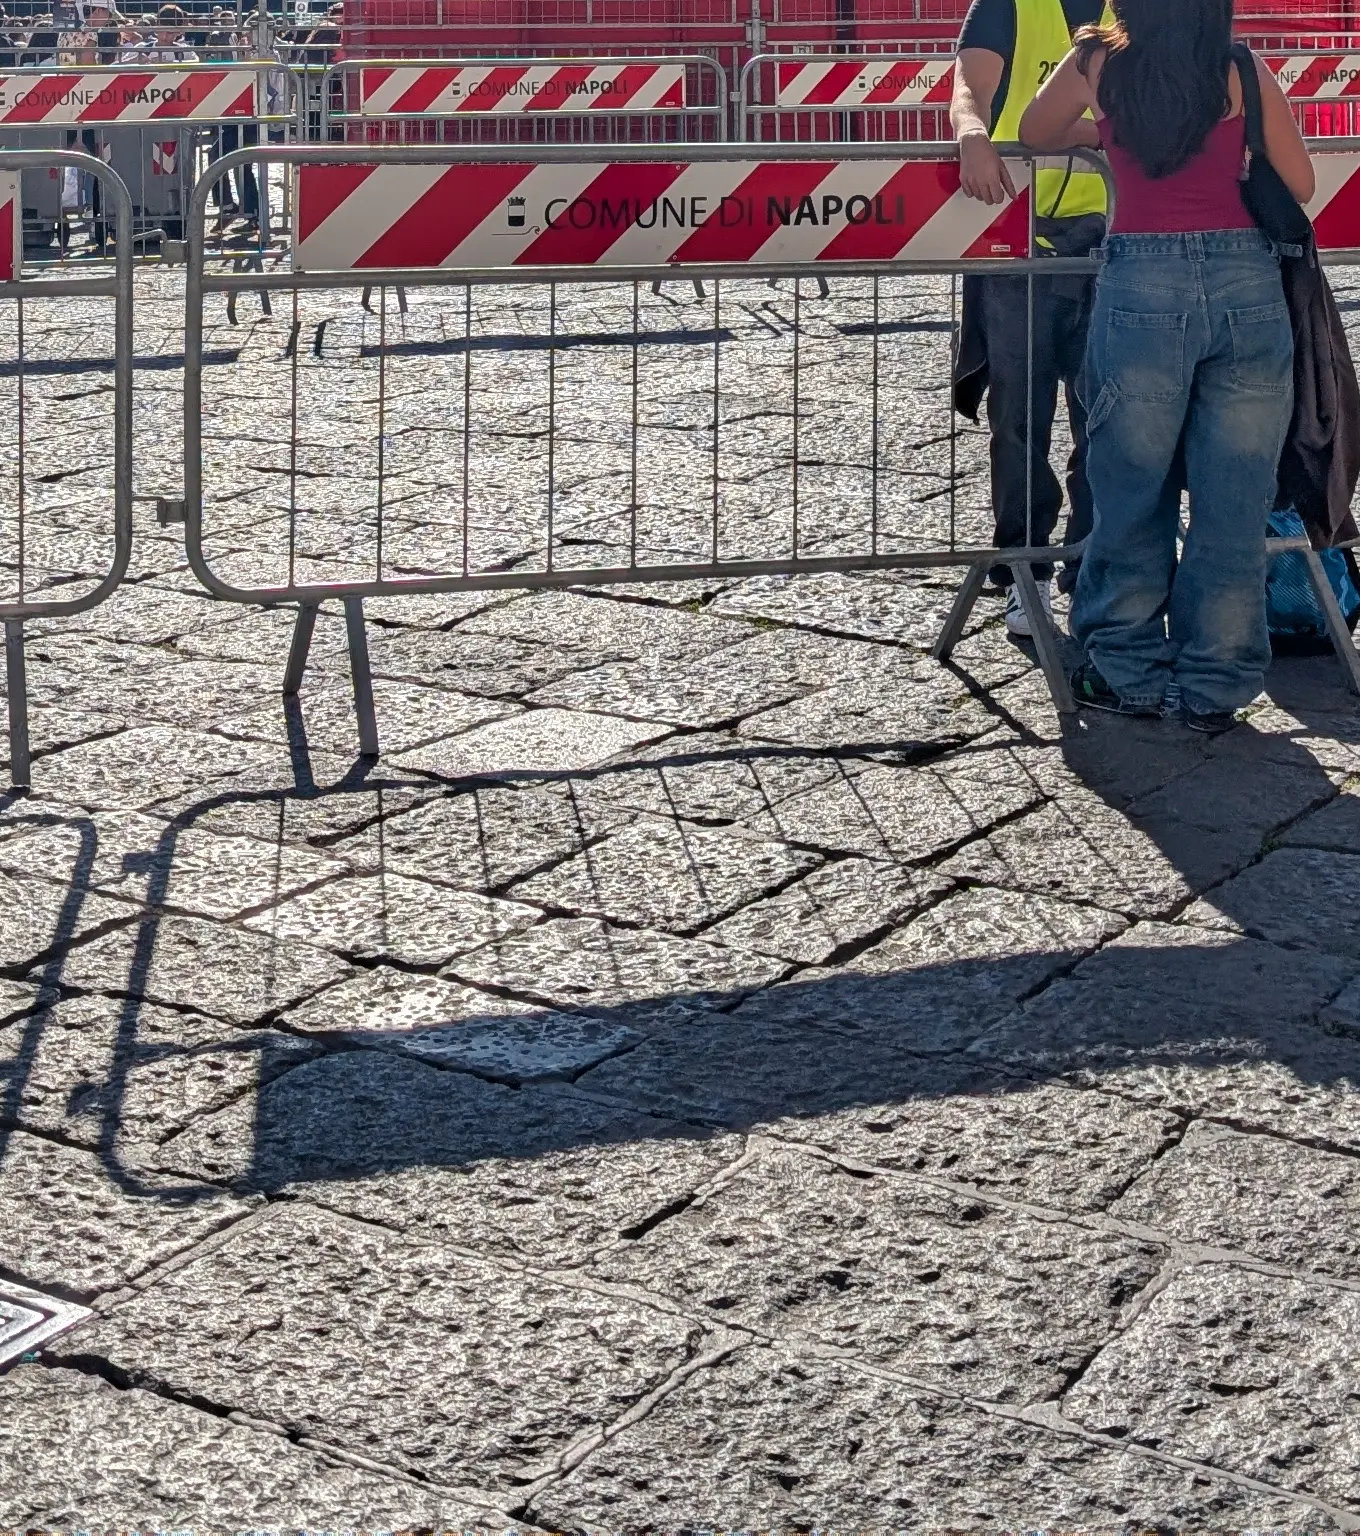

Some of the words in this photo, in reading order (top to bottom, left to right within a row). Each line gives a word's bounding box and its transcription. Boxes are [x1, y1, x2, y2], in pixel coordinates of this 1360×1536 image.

[468, 81, 540, 96] COMUNE
[545, 81, 561, 95] DI
[565, 79, 628, 95] NAPOLI
[872, 75, 935, 89] COMUNE
[14, 90, 94, 107] COMUNE
[99, 90, 116, 105] DI
[123, 88, 192, 104] NAPOLI
[544, 196, 707, 230] COMUNE
[719, 196, 752, 226] DI
[766, 194, 907, 226] NAPOLI
